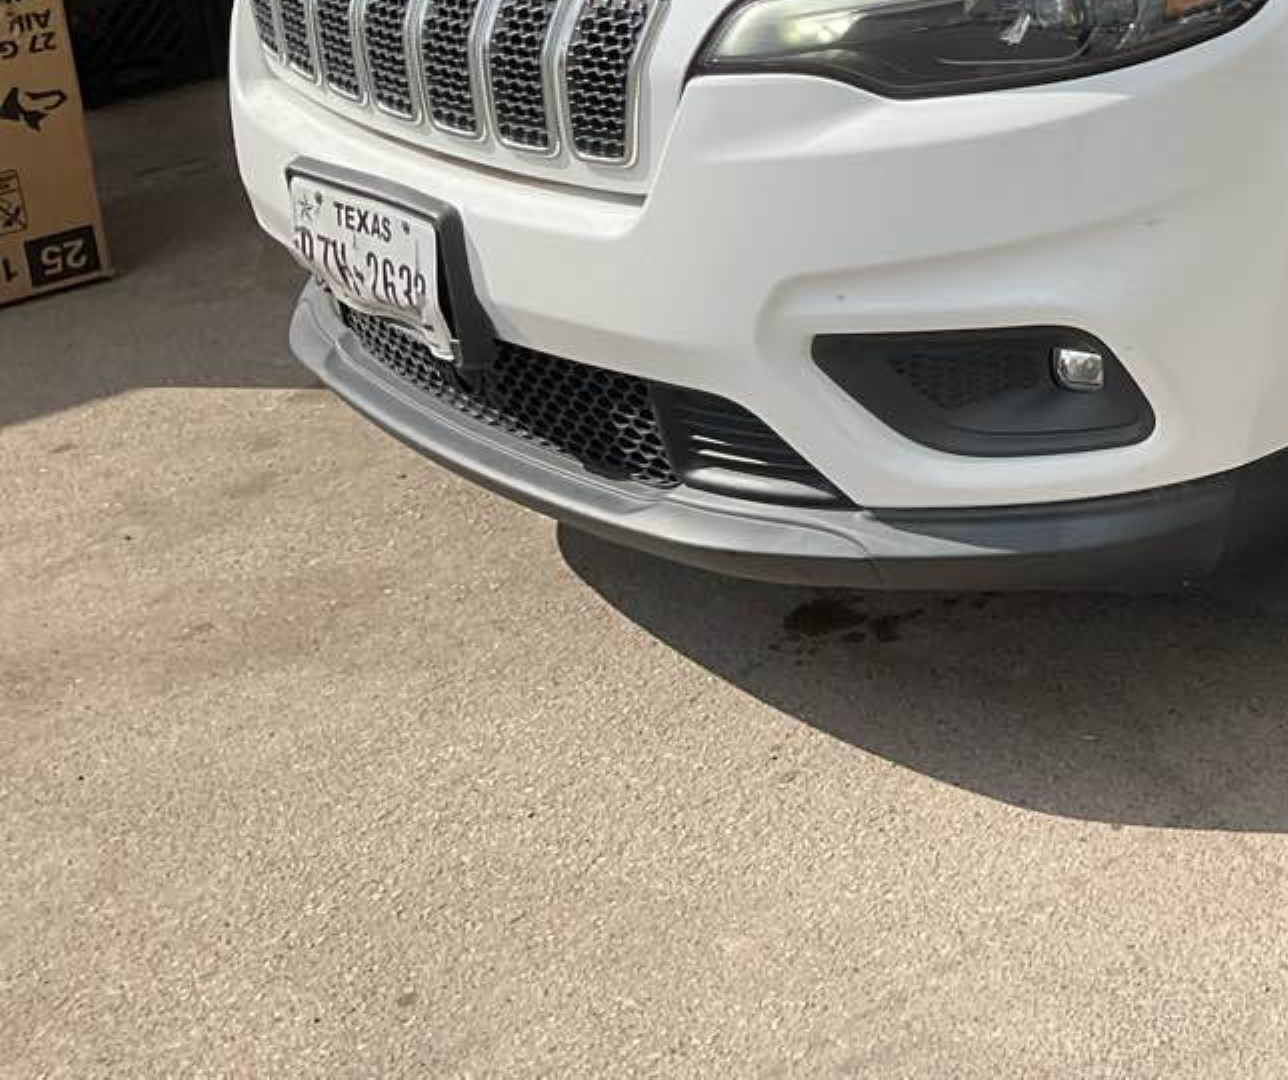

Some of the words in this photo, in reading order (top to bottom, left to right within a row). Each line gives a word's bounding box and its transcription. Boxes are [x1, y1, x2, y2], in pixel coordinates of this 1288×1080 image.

[29, 31, 57, 54] 27
[333, 191, 392, 243] TEXAS
[41, 239, 87, 276] 25
